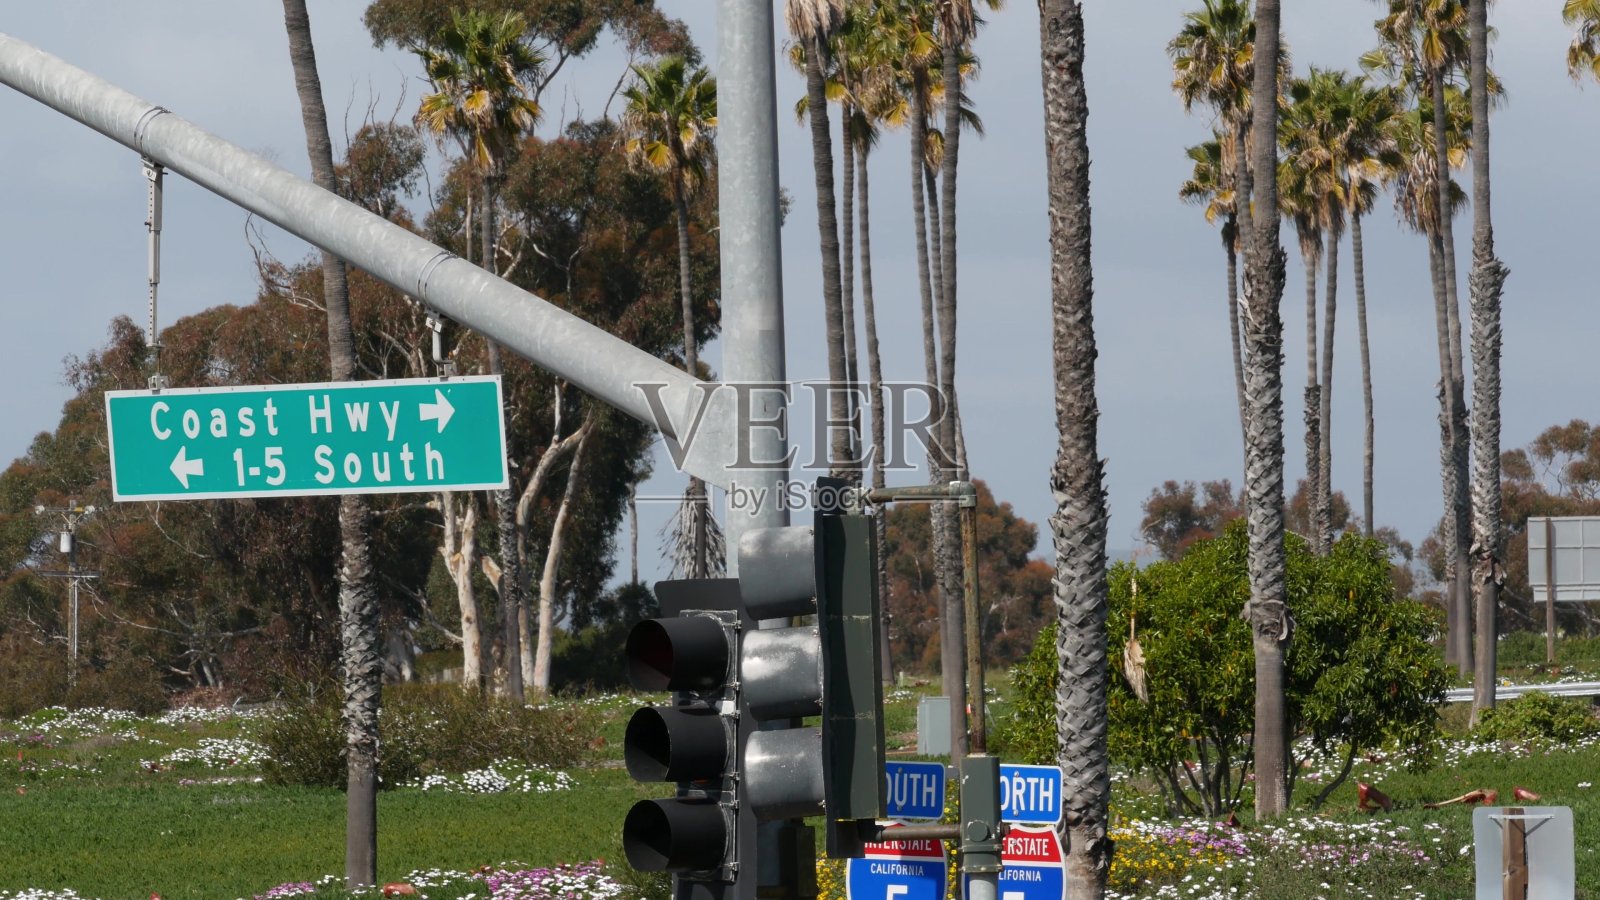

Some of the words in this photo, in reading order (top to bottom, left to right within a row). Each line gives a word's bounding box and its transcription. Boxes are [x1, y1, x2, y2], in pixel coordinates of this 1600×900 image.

[150, 397, 279, 440] Coast
[309, 394, 400, 441] Hwy
[314, 441, 445, 484] South
[1000, 775, 1054, 812] ORTH
[1001, 837, 1050, 856] ERSTATE
[870, 863, 924, 876] CALIFORNIA
[998, 869, 1042, 882] LIFORNIA
